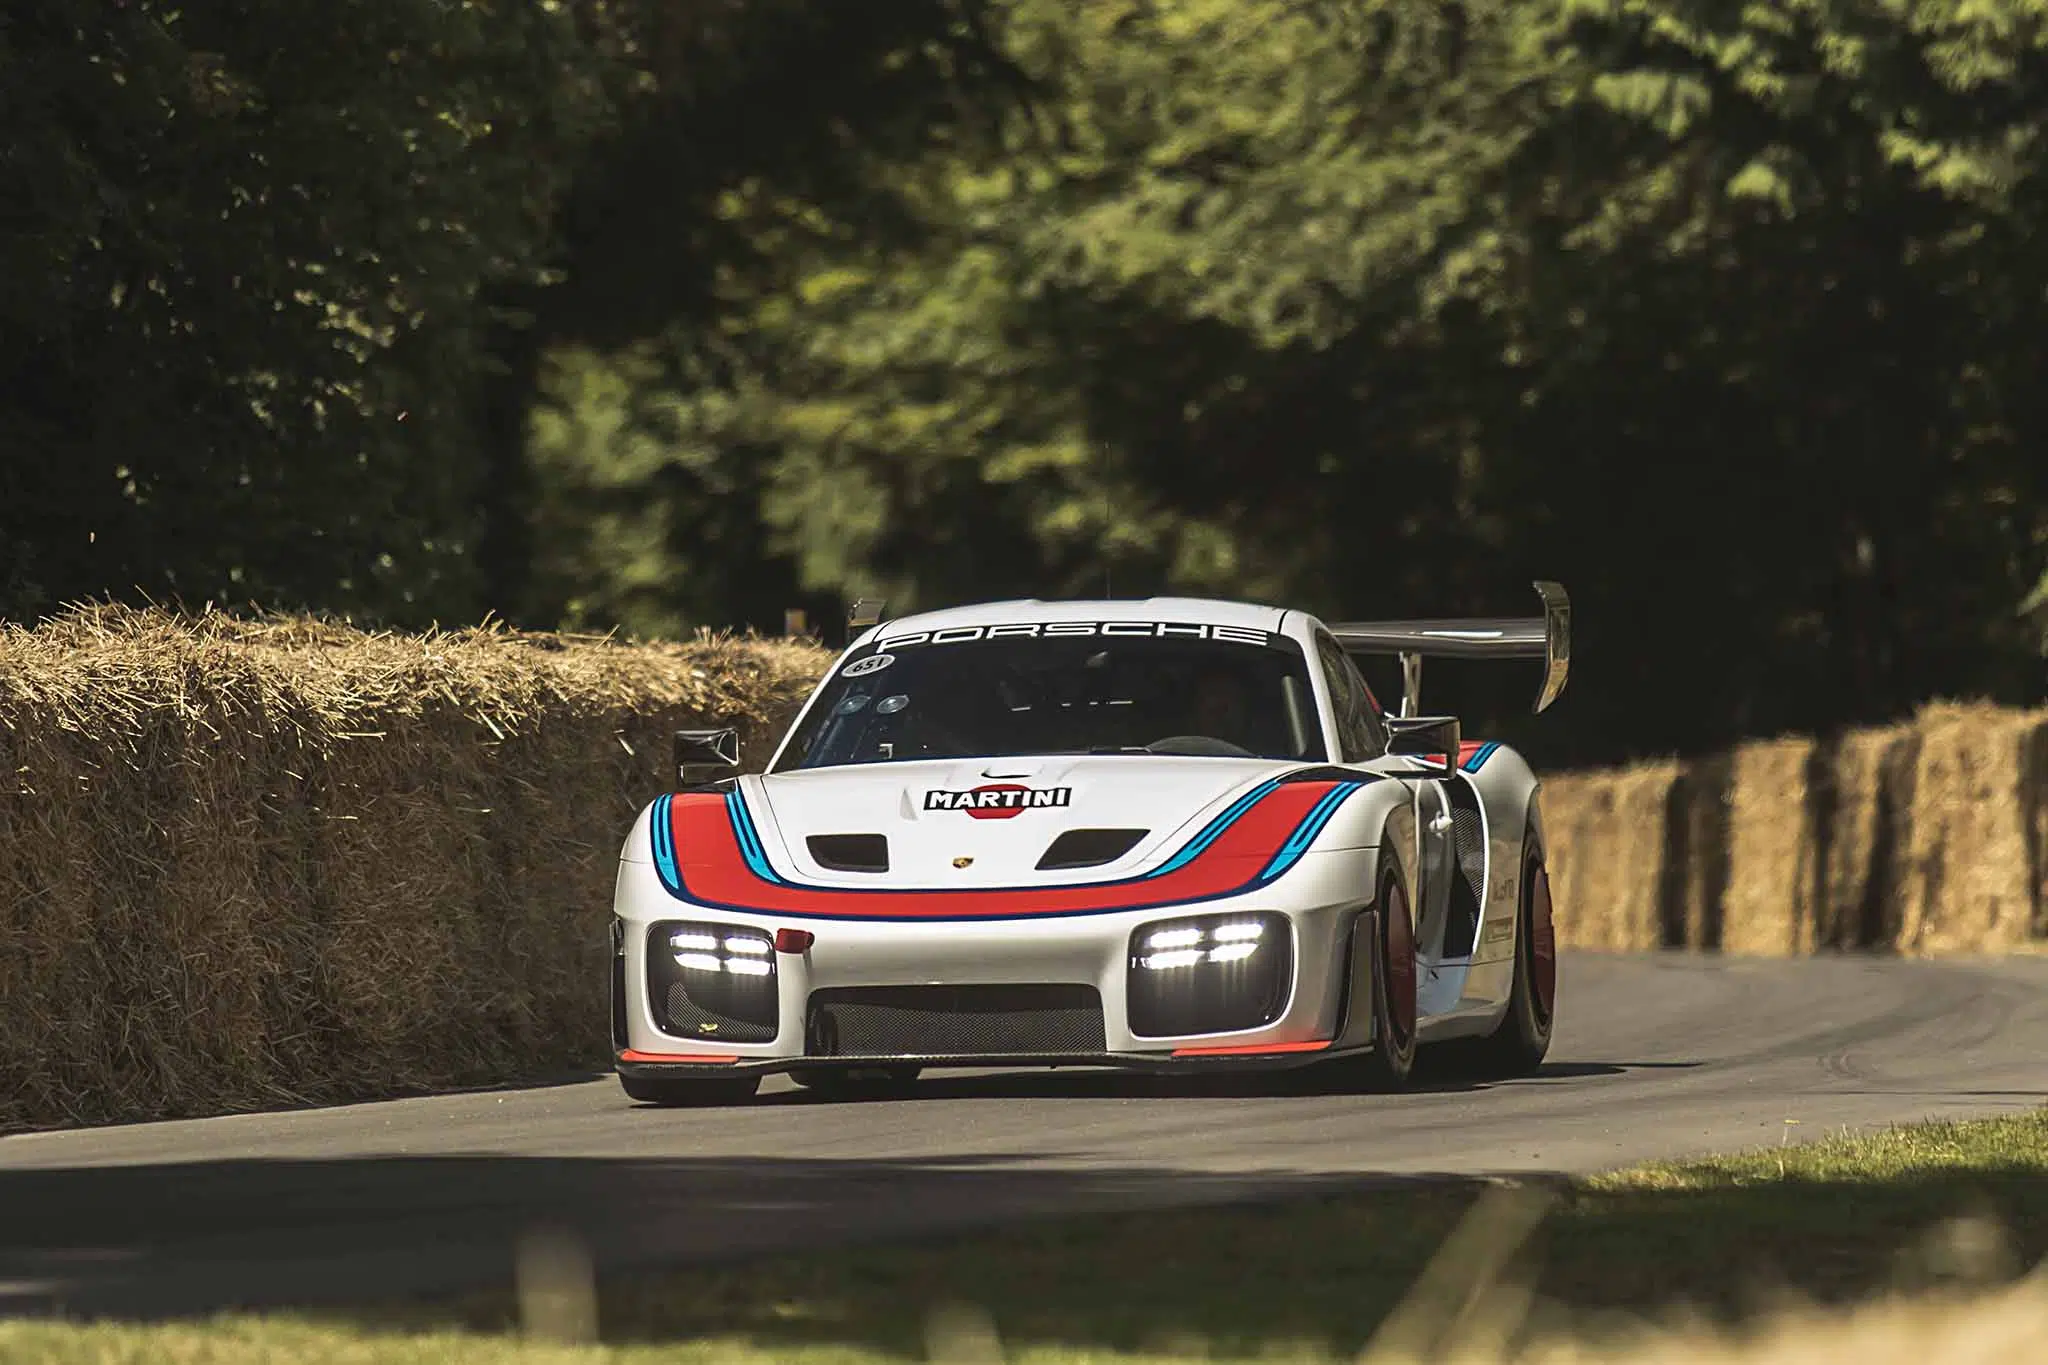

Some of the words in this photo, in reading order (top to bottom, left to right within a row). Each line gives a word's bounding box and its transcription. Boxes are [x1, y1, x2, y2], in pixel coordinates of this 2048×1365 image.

[875, 622, 1268, 654] PORSCHE
[852, 657, 885, 673] 651
[928, 788, 1067, 809] MARTINI
